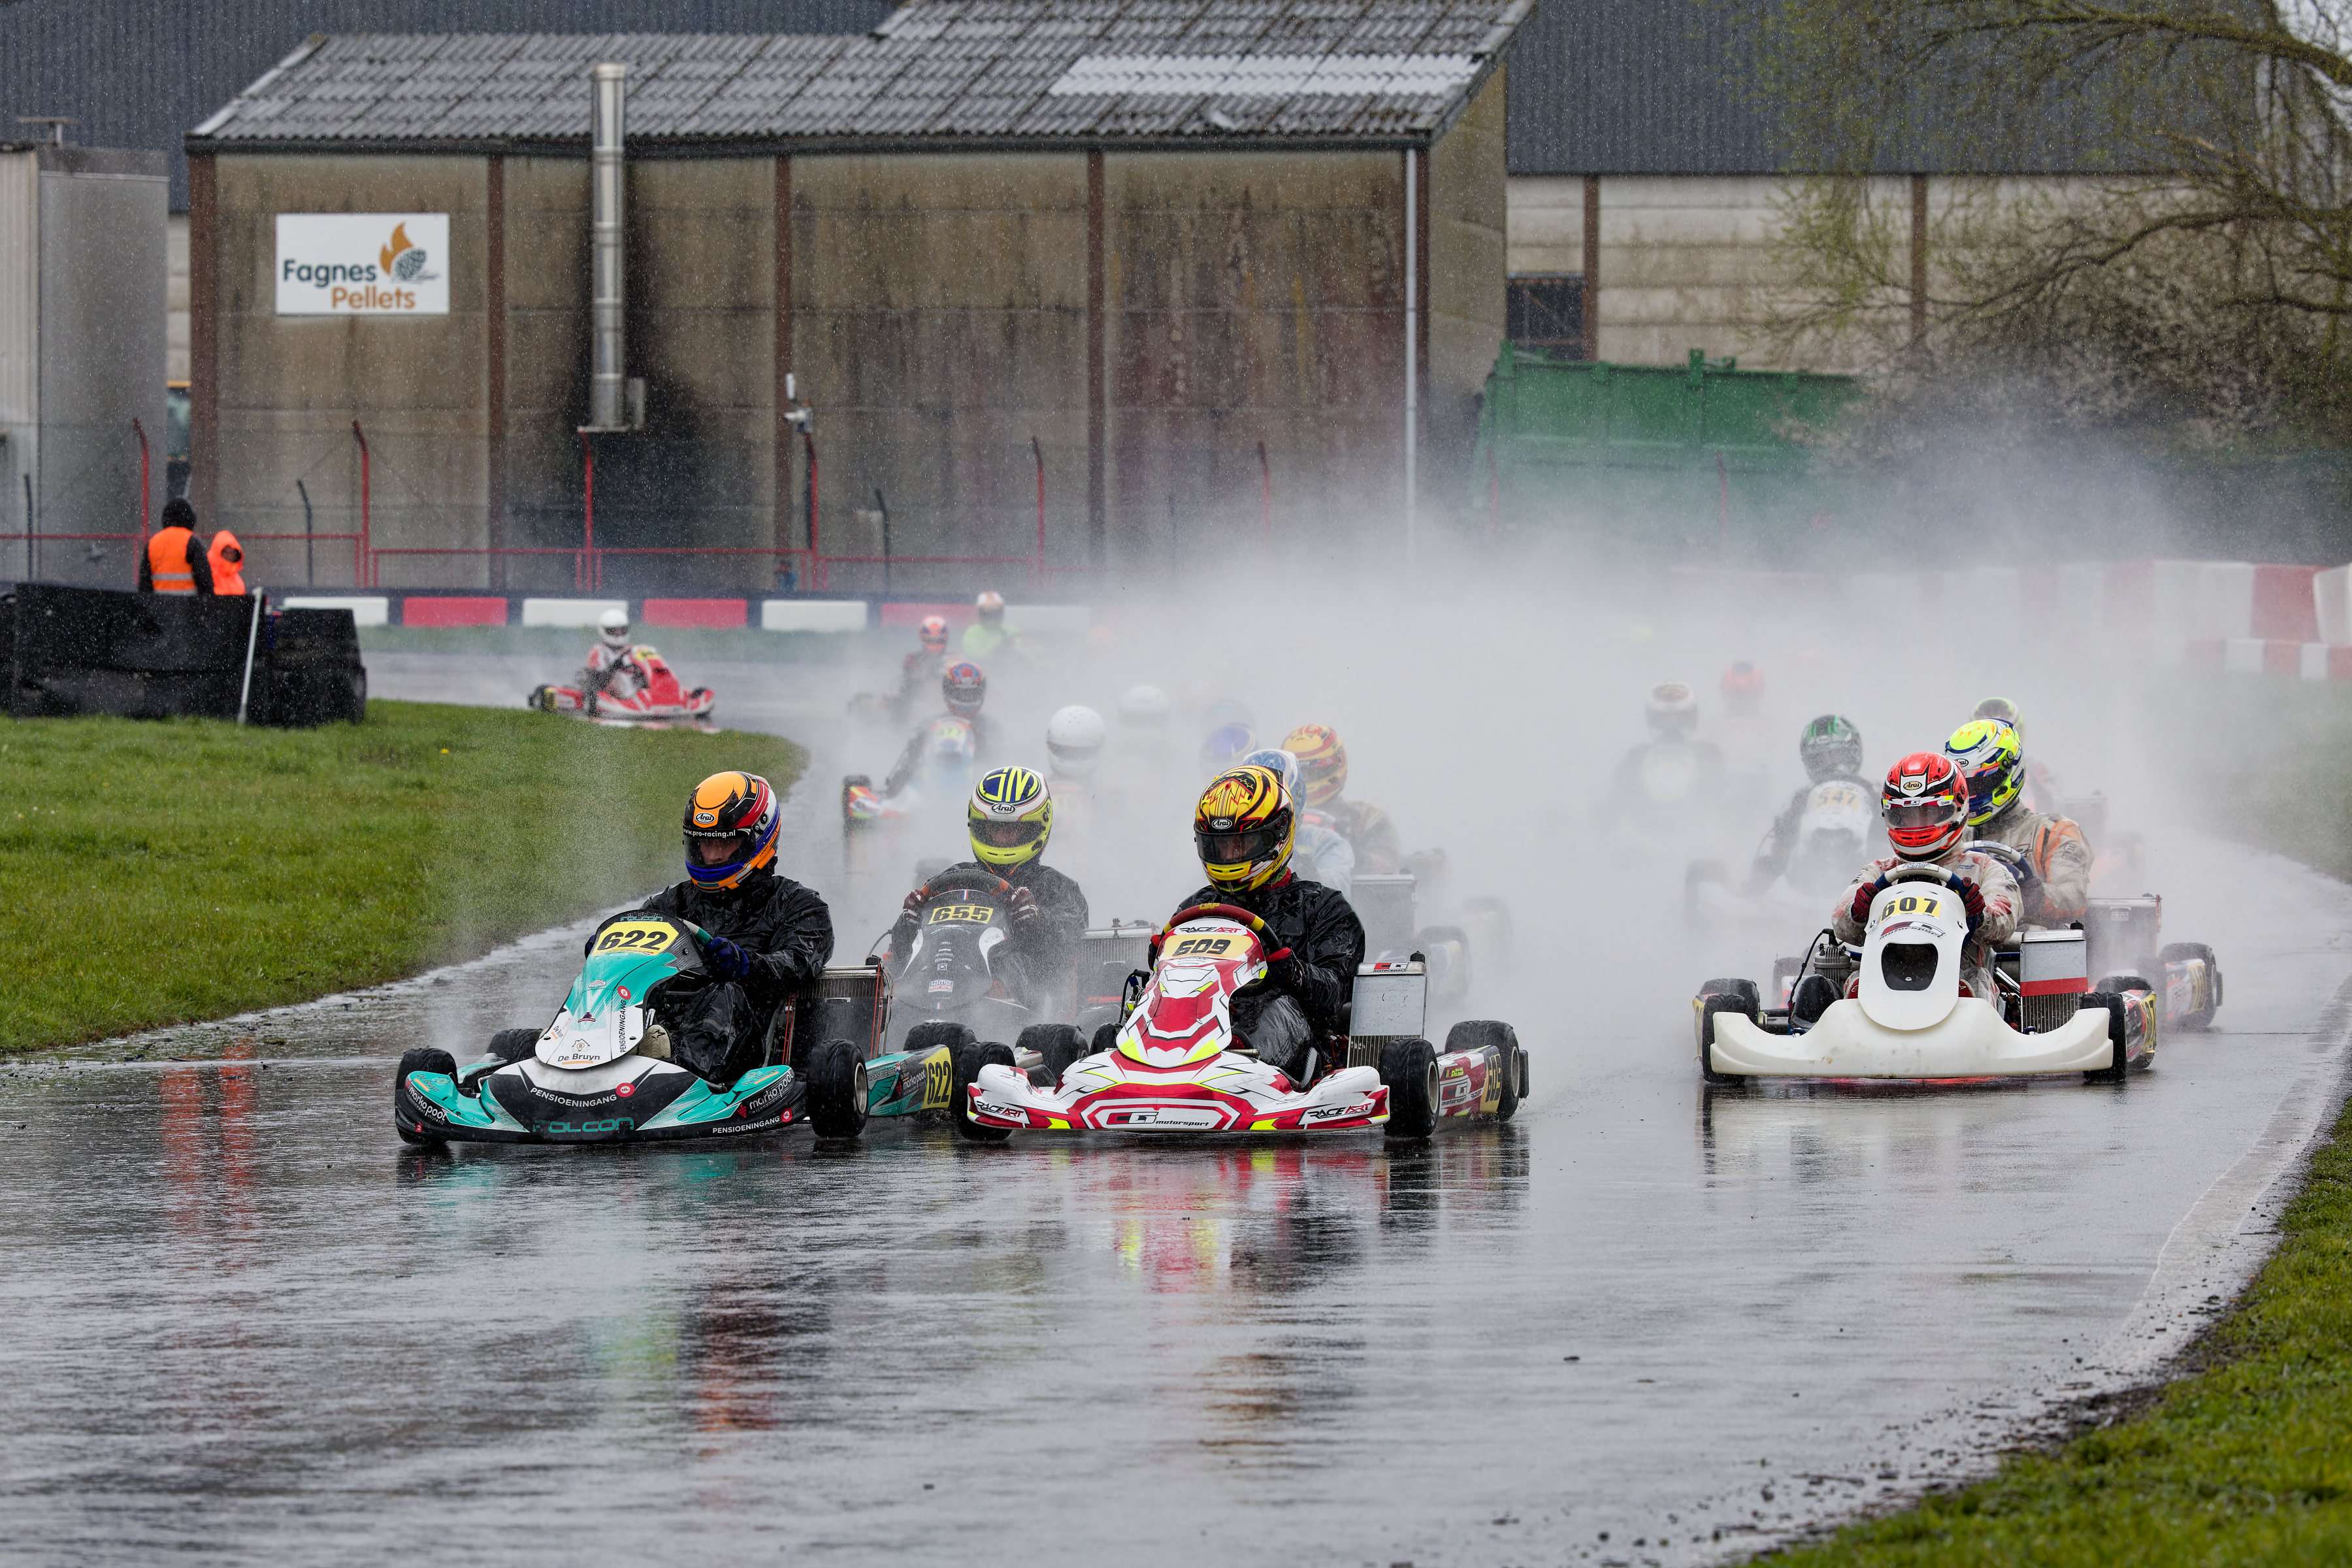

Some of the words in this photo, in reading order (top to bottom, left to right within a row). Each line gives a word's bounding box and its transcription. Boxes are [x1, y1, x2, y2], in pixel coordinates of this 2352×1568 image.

[283, 259, 377, 288] Fagnes
[331, 286, 416, 310] Pellets
[992, 804, 1013, 812] Arai
[932, 906, 991, 924] 655
[1882, 897, 1938, 921] 607
[597, 930, 668, 951] 622
[1172, 939, 1231, 956] 609
[618, 999, 627, 1053] PENSIOENINGANG
[928, 1060, 952, 1105] 622
[408, 1086, 427, 1109] marko
[530, 1087, 617, 1107] PENSIOENINGANG
[749, 1088, 778, 1110] marko
[712, 1116, 781, 1134] PENSIOENINGANG
